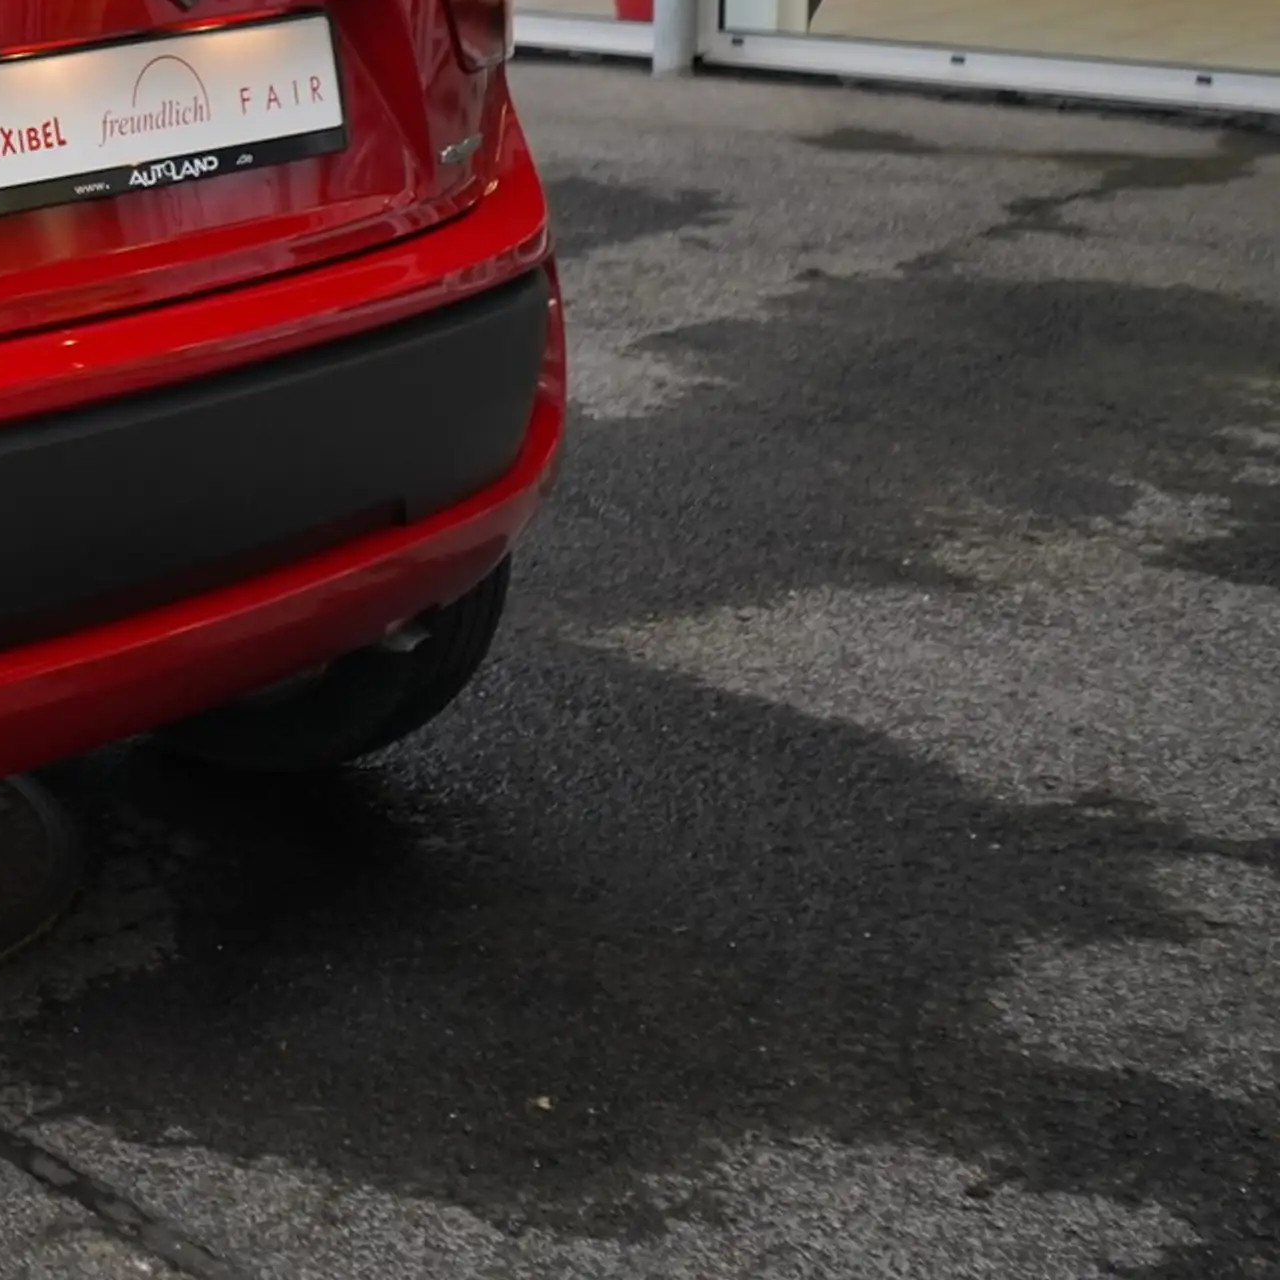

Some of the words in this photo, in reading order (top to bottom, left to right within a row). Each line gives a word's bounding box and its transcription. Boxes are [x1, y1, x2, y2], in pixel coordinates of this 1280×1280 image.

[98, 99, 204, 147] freundlich
[240, 75, 324, 116] FAIR
[128, 155, 219, 187] AUTOLAND
